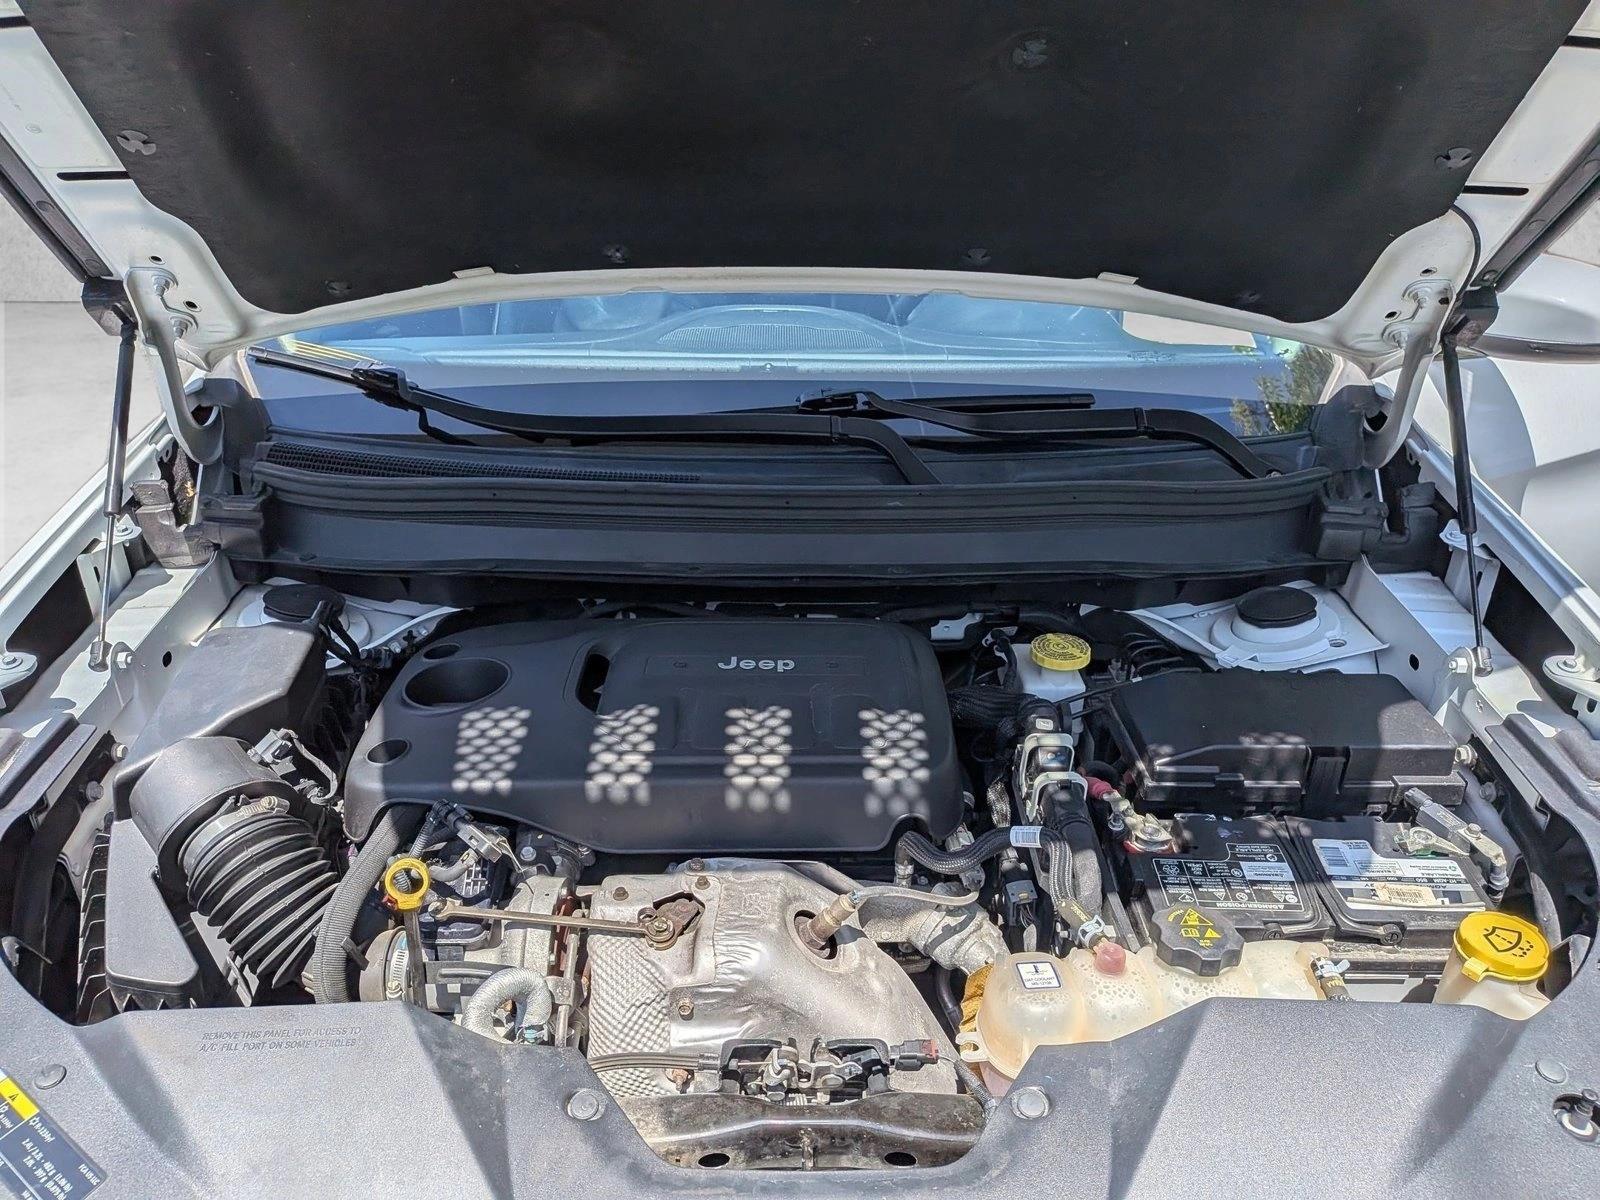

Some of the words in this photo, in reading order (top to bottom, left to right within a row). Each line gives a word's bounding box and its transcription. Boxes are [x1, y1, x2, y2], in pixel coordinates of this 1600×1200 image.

[717, 656, 795, 672] Jeep
[202, 1032, 239, 1041] REMOVE
[241, 1031, 261, 1039] THIS
[263, 1030, 290, 1038] PANEL
[293, 1028, 311, 1037] FOR
[314, 1027, 348, 1036] ACCESS
[349, 1026, 361, 1035] TO
[200, 1043, 217, 1052] A/C
[221, 1043, 239, 1051] FILL
[242, 1042, 267, 1050] PORT
[269, 1041, 283, 1050] ON
[284, 1040, 311, 1049] SOME
[314, 1038, 357, 1048] VEHICLES
